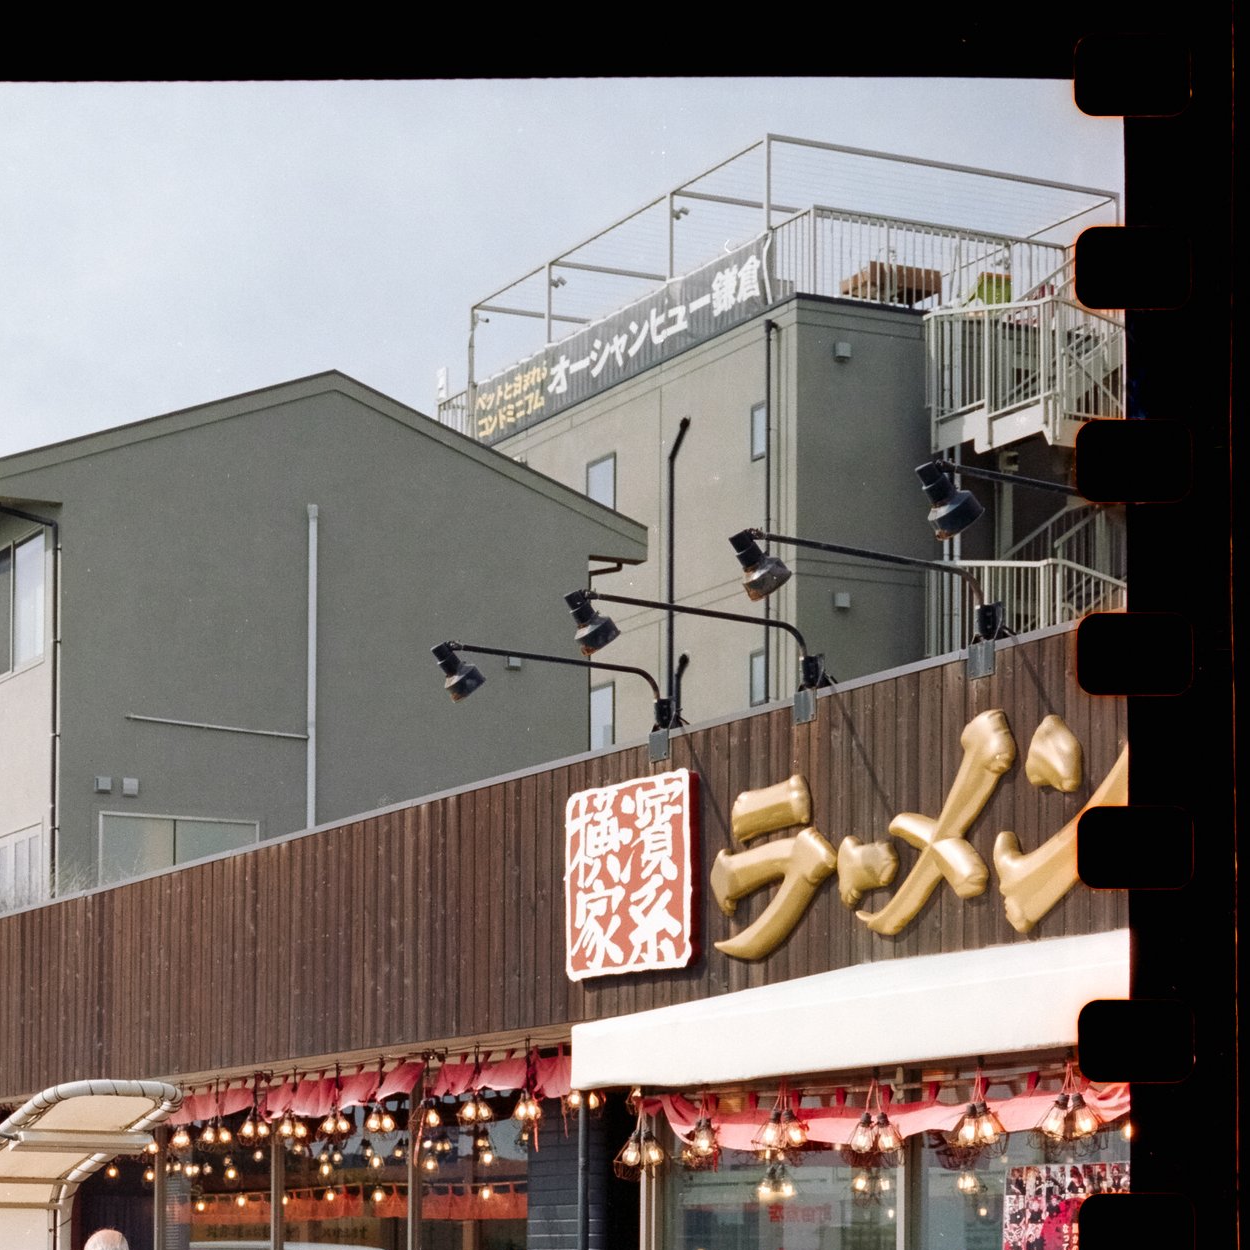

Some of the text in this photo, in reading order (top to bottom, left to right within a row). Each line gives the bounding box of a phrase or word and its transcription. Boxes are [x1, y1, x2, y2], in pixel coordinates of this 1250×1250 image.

[548, 254, 761, 394] オーシャンビュー鎌倉
[476, 360, 547, 410] ペットと泊まれる
[478, 389, 544, 437] コンドミニアム
[570, 874, 688, 969] 家系
